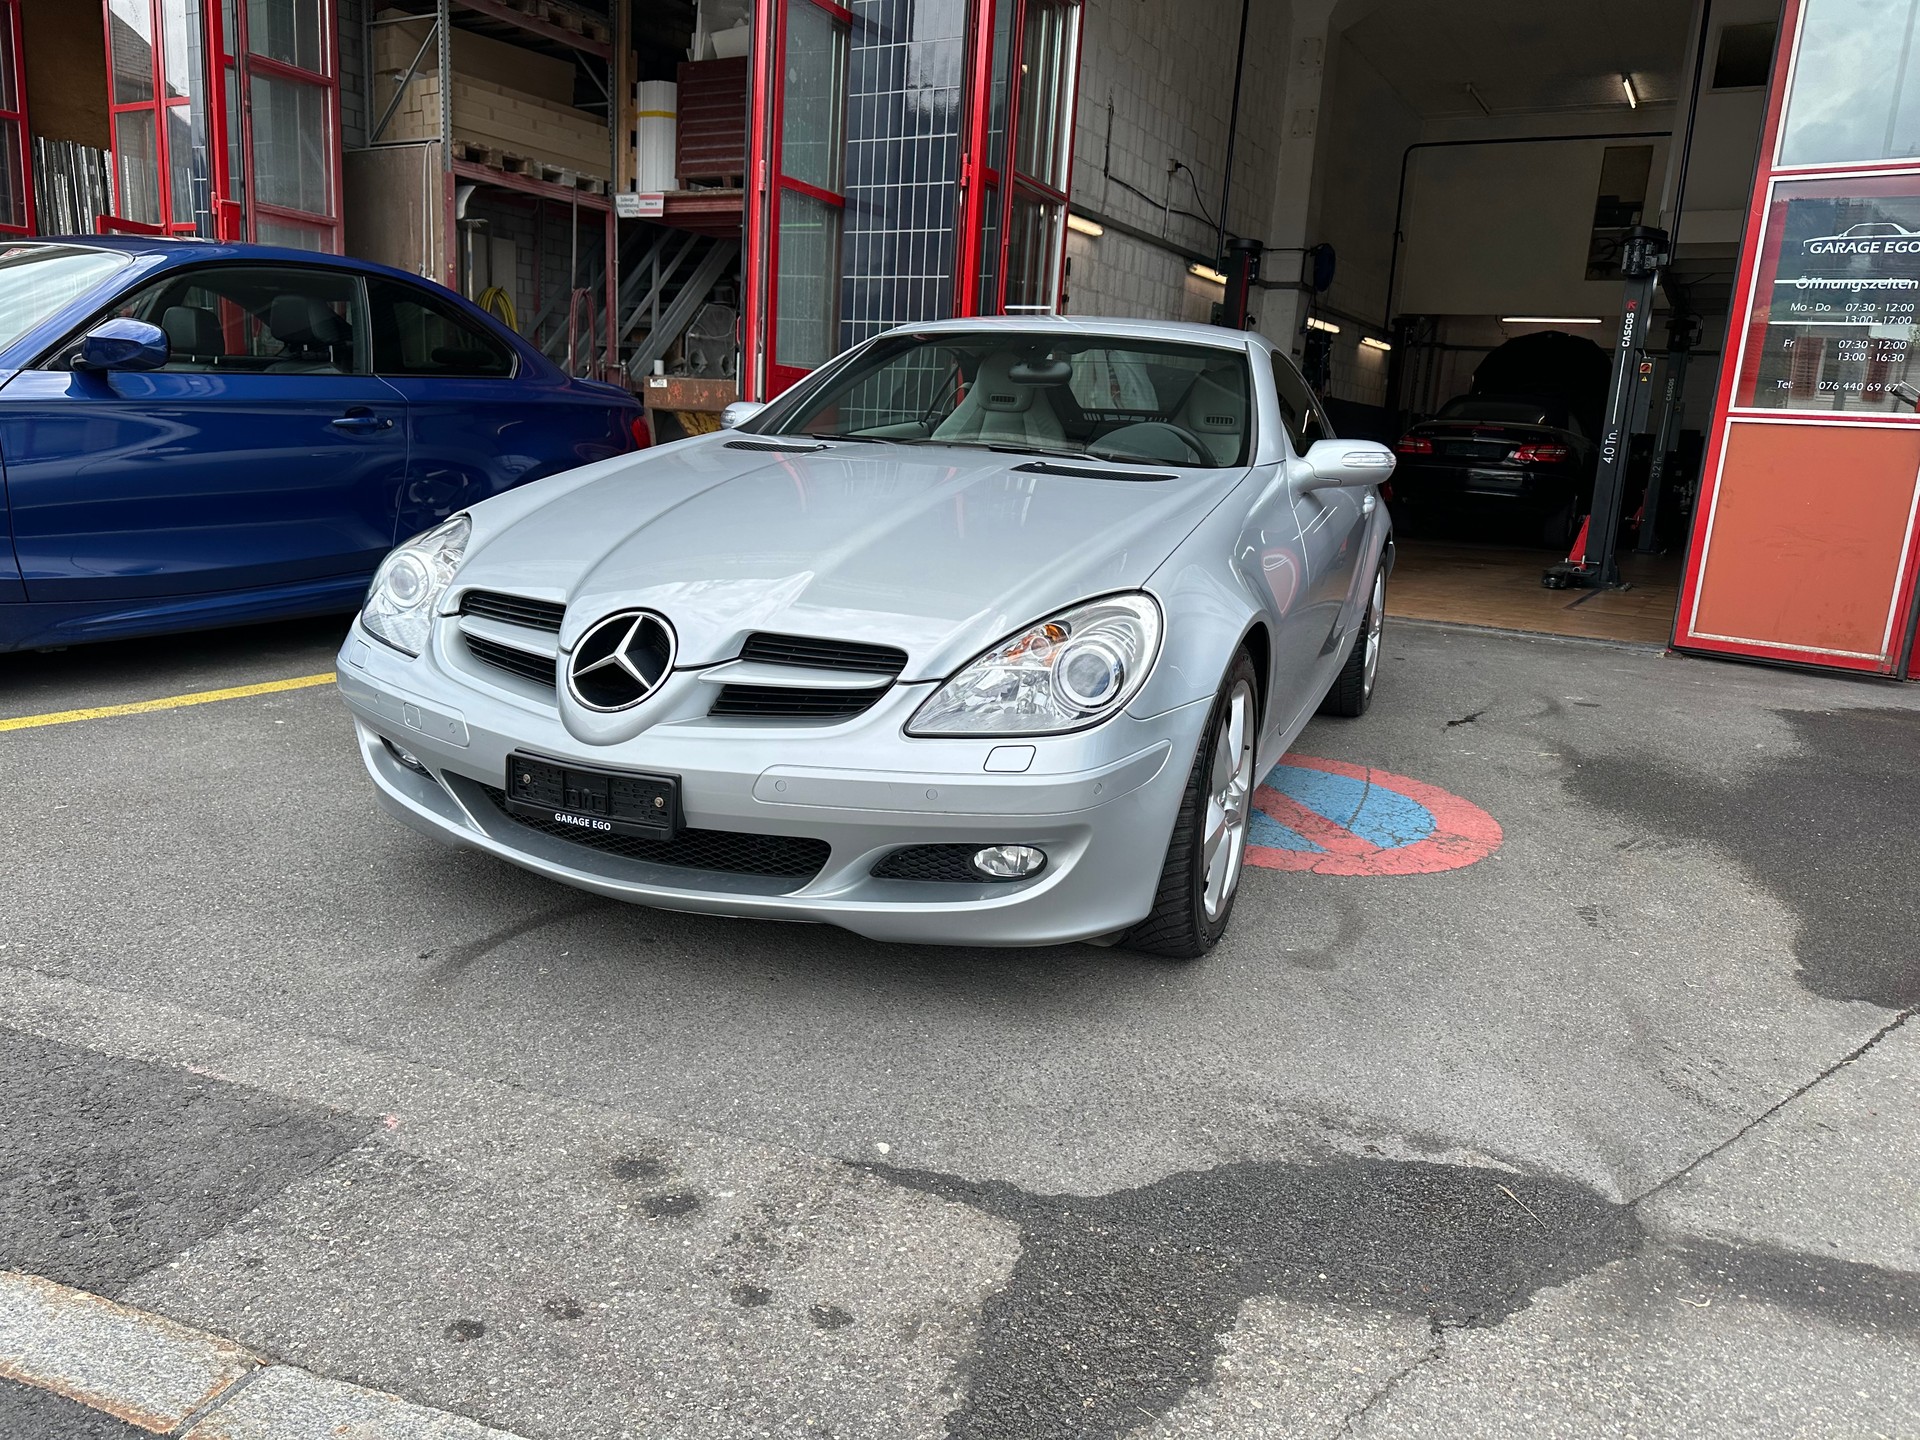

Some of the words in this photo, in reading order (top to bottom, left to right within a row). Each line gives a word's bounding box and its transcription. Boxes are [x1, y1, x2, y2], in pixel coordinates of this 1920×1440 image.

[1810, 241, 1881, 254] GARAGE
[1884, 241, 1920, 254] EGO
[1795, 276, 1919, 292] Öffnungszeiten
[1790, 303, 1807, 311] Mo
[1815, 303, 1831, 312] Do
[1845, 303, 1876, 312] 07:30
[1885, 303, 1915, 312] 12:00
[1845, 316, 1873, 324] 13:00
[1883, 316, 1912, 325] 17:00
[1621, 312, 1635, 348] CASCOS
[1783, 339, 1795, 348] Fr
[1838, 340, 1869, 349] 07:30
[1878, 341, 1907, 350] 12:00
[1837, 353, 1866, 361] 13:00
[1875, 353, 1905, 362] 16:30
[1665, 378, 1675, 401] CASCOS
[1776, 381, 1794, 390] Tel:
[1818, 381, 1840, 390] 076
[1843, 382, 1864, 391] 440
[1867, 383, 1881, 391] 69
[1884, 383, 1899, 392] 67
[1605, 429, 1618, 446] Tn.
[1602, 446, 1615, 464] 4.0
[555, 813, 590, 827] GARAGE
[592, 820, 611, 831] EGO
